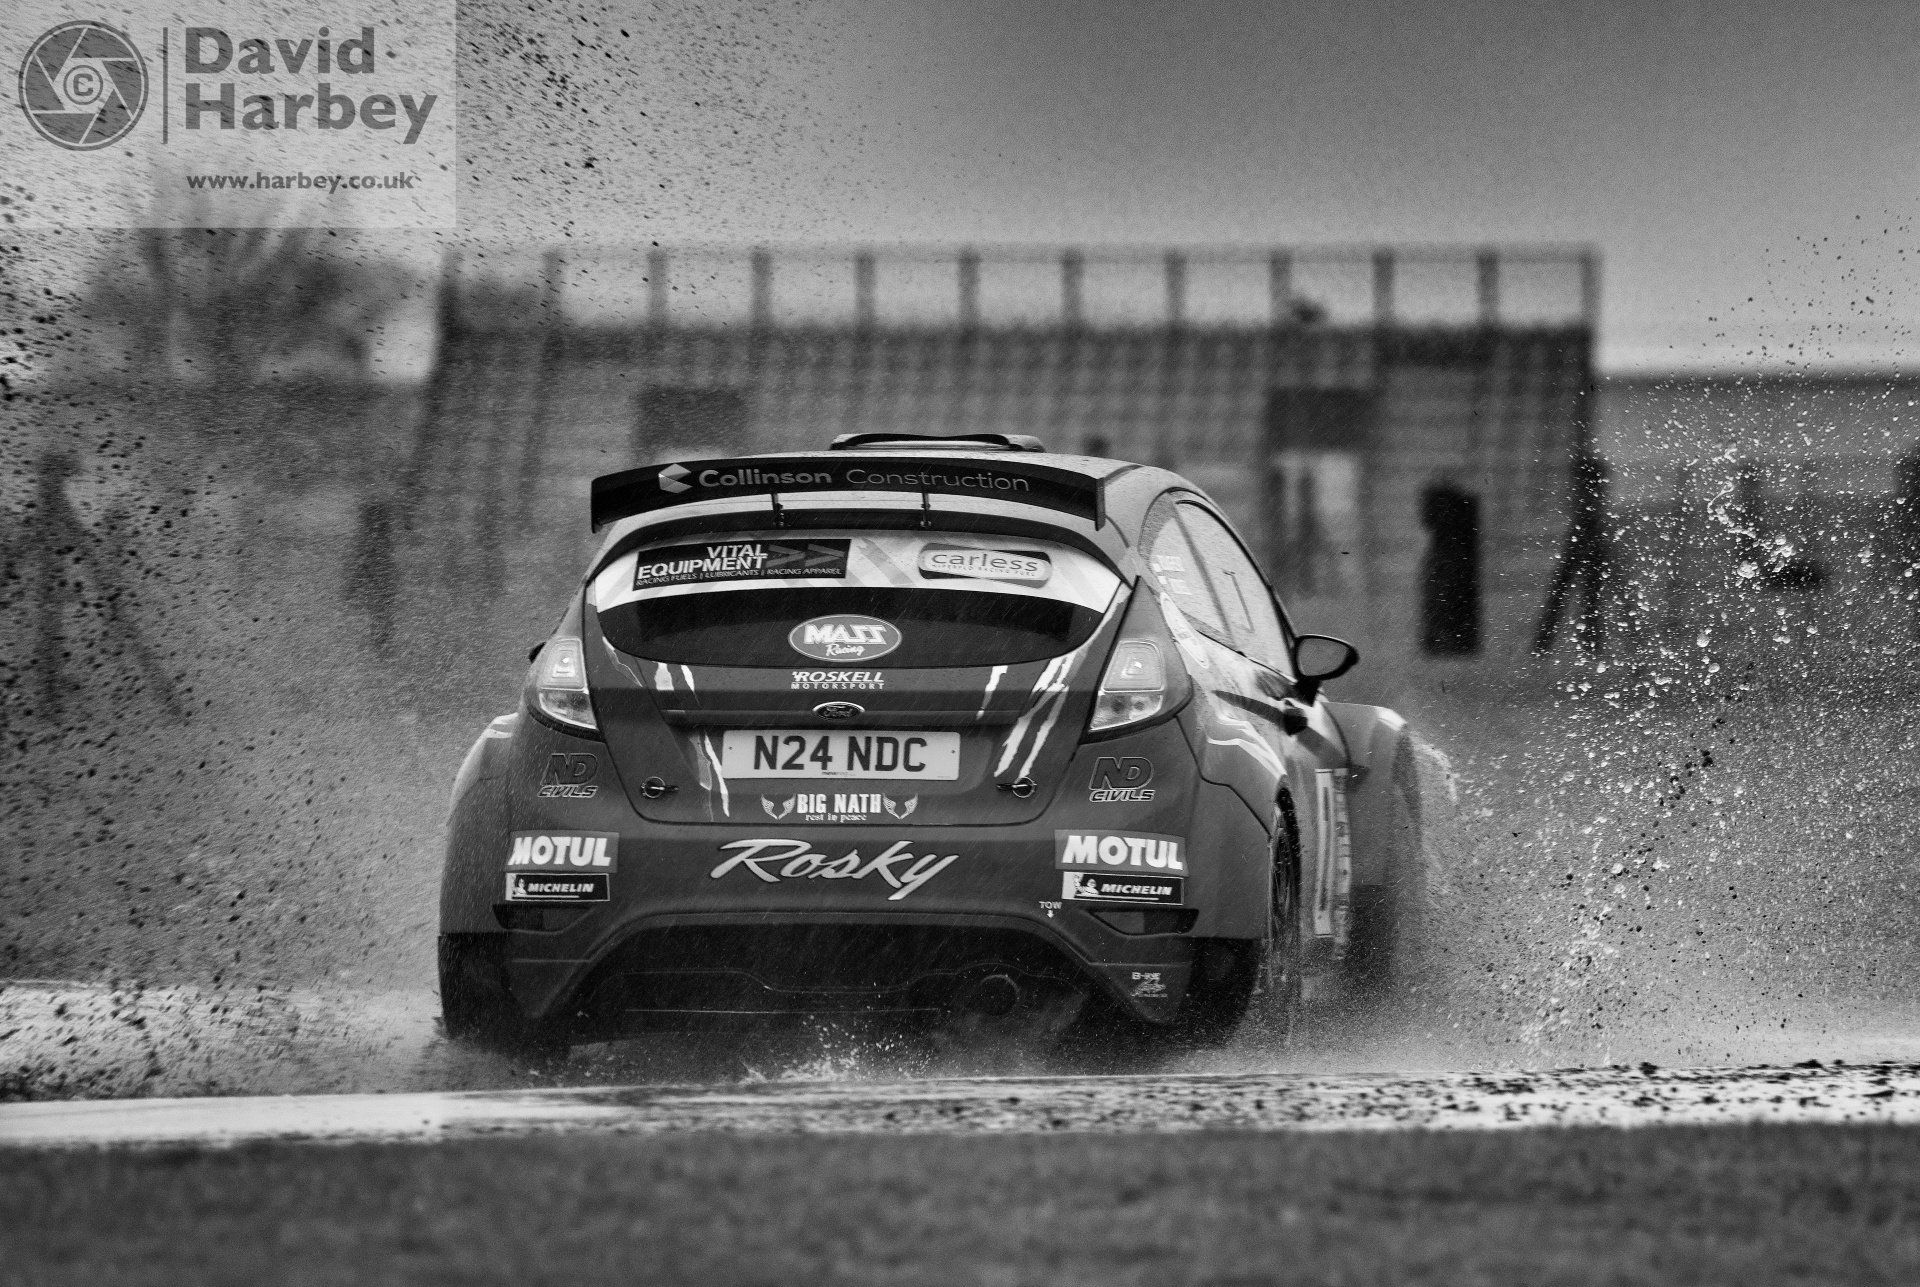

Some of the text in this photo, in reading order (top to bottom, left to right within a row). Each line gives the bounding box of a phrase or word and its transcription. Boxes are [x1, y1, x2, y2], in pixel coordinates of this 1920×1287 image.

[699, 468, 1030, 492] Collinson Construction
[706, 544, 769, 559] VITAL
[637, 555, 768, 580] EQUIPMENT
[931, 553, 1038, 572] carless
[636, 567, 843, 586] RACING FUELS LUBRICANTS RACING APPAREL
[825, 643, 866, 657] Racing
[793, 671, 884, 682] ROSKELL
[754, 735, 928, 772] N24 NDC
[540, 752, 598, 786] ND
[1088, 756, 1155, 791] ND
[537, 785, 600, 798] CIVILS
[1088, 789, 1156, 803] CIVILS
[796, 793, 882, 814] BIG NATH
[805, 813, 824, 821] rest
[840, 813, 867, 823] peace
[507, 835, 612, 867] MOTUL
[1061, 835, 1184, 871] MOTUL
[710, 838, 960, 901] Rosky
[527, 883, 594, 893] MICHELIN
[1100, 883, 1173, 896] MICHELIN
[1038, 901, 1063, 910] TOW
